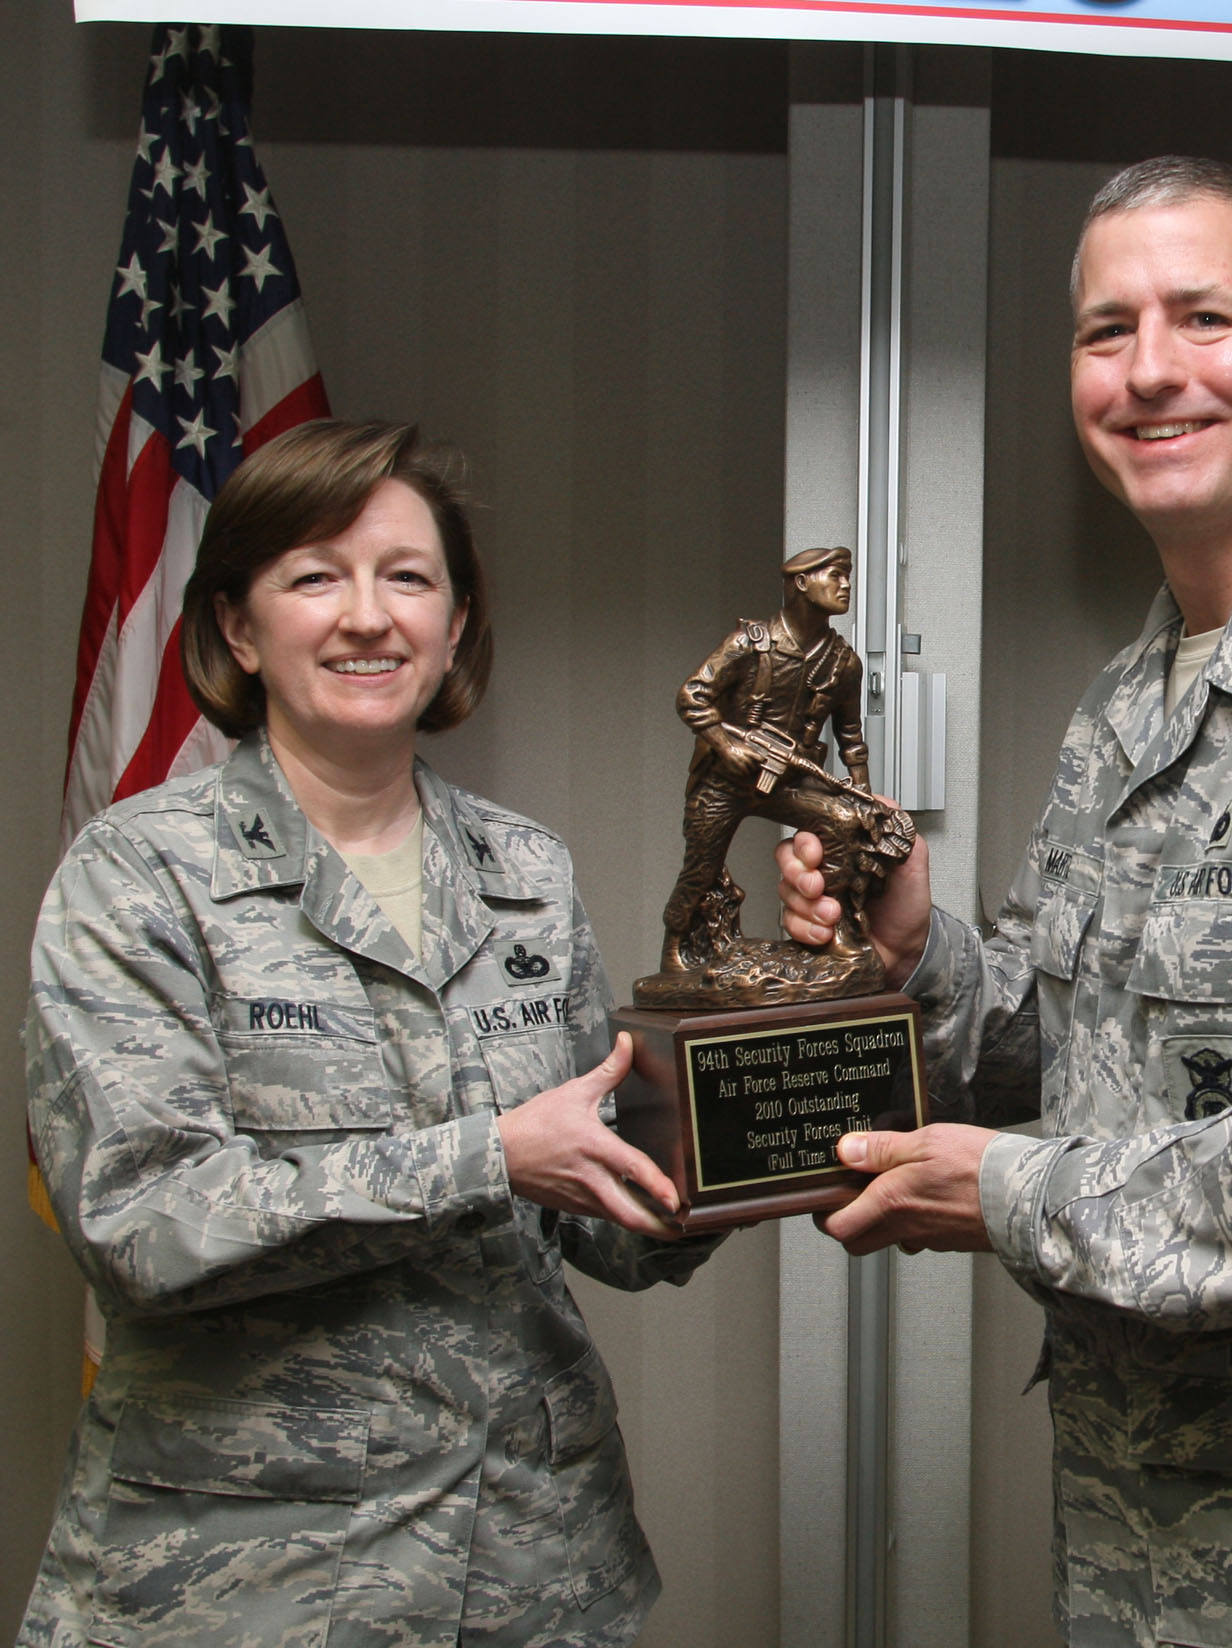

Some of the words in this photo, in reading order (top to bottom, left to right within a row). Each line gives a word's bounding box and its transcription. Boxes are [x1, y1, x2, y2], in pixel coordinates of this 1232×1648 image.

[249, 1002, 323, 1030] ROEHL
[473, 1006, 517, 1033] U.S.
[520, 1000, 551, 1027] AIR
[697, 1050, 729, 1072] 94th
[735, 1042, 791, 1067] Security
[798, 1037, 839, 1060] Forces
[845, 1028, 904, 1058] Squadron
[718, 1079, 737, 1098] Air
[744, 1075, 776, 1096] Force
[782, 1070, 829, 1091] Reserve
[834, 1058, 890, 1082] Command
[755, 1100, 783, 1121] 2010
[788, 1092, 860, 1115] Outstanding
[747, 1126, 798, 1149] Security
[804, 1121, 842, 1145] Forces
[847, 1114, 873, 1133] Unit
[798, 1148, 826, 1167] Time
